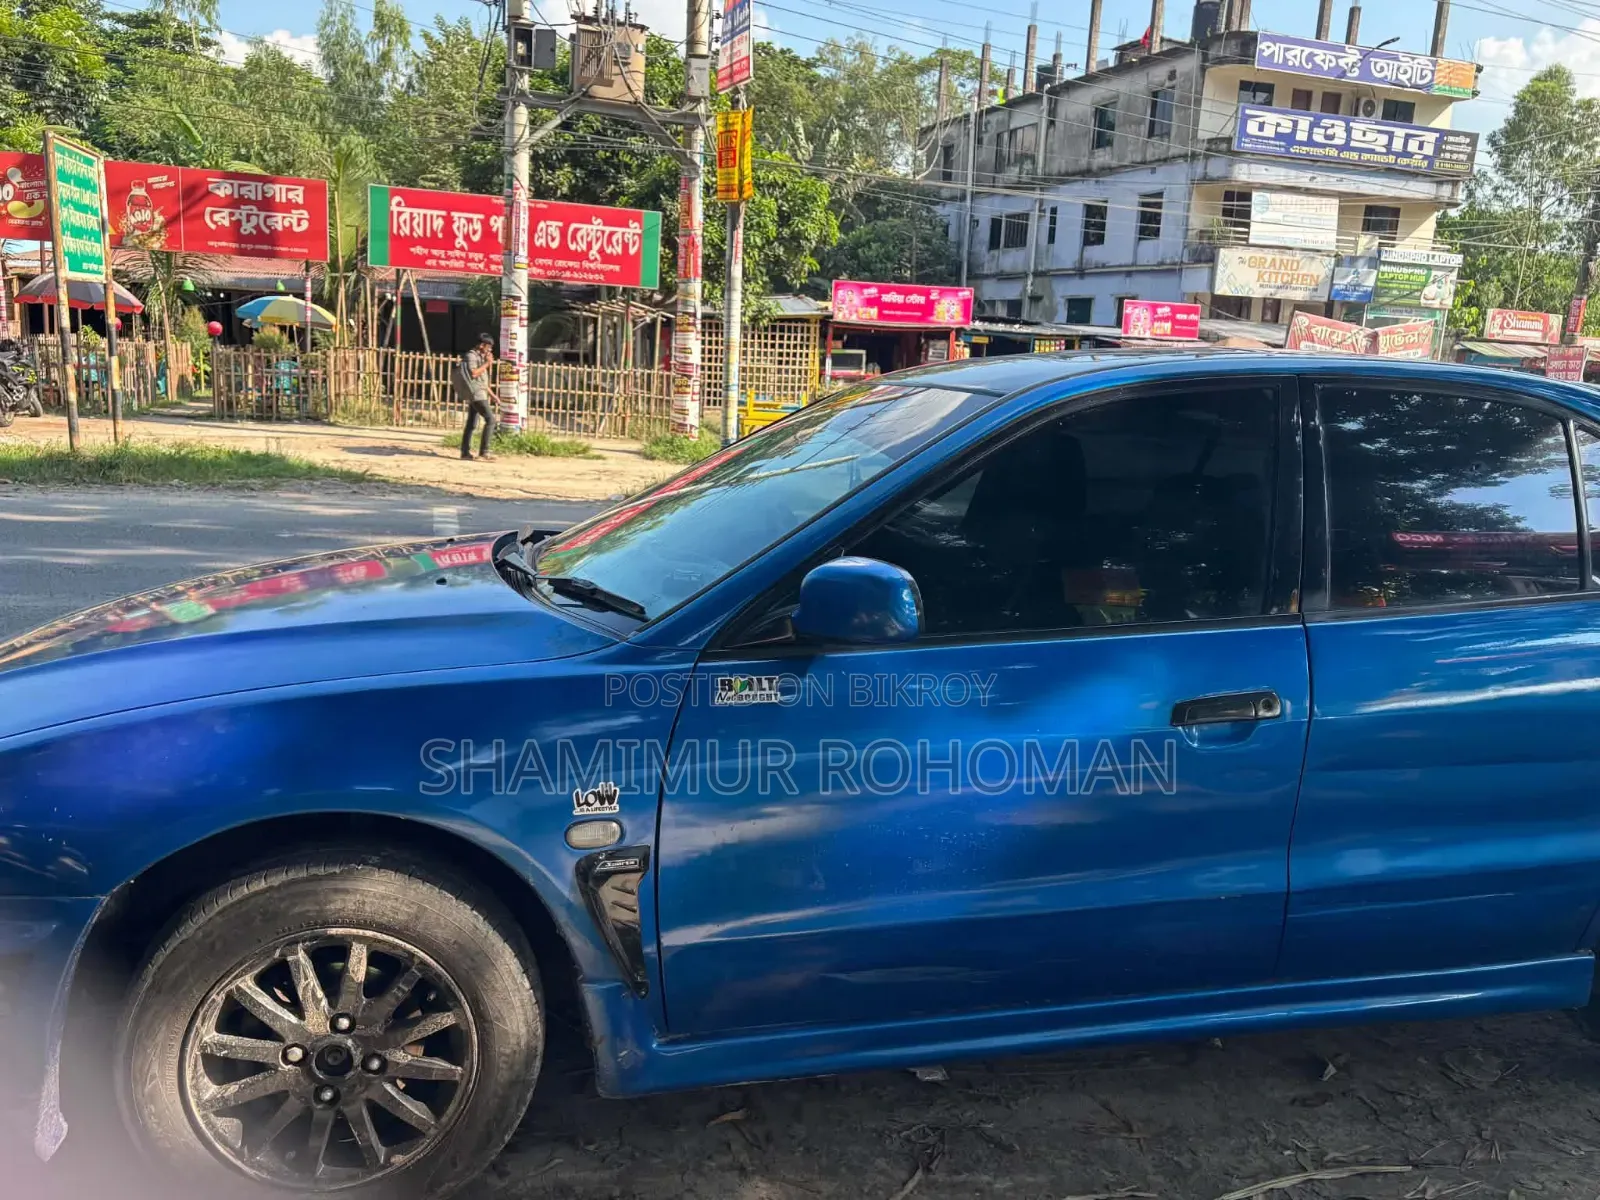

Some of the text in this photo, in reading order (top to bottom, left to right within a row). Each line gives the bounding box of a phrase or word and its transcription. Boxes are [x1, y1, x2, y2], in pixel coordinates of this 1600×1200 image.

[1259, 41, 1362, 77] পারফেক্ট
[1370, 53, 1435, 87] আইটি
[207, 178, 304, 204] কারাগার
[204, 205, 310, 235] রেস্টুরেন্ট
[390, 196, 447, 239] রিয়াদ
[450, 211, 485, 251] ফুড
[534, 220, 564, 250] এন্ড
[567, 216, 643, 261] রেস্টুরেন্ট
[1248, 256, 1300, 271] GRAND
[1379, 272, 1409, 281] LAPTOP
[1257, 270, 1320, 287] KITCHEN
[574, 783, 618, 808] LOW
